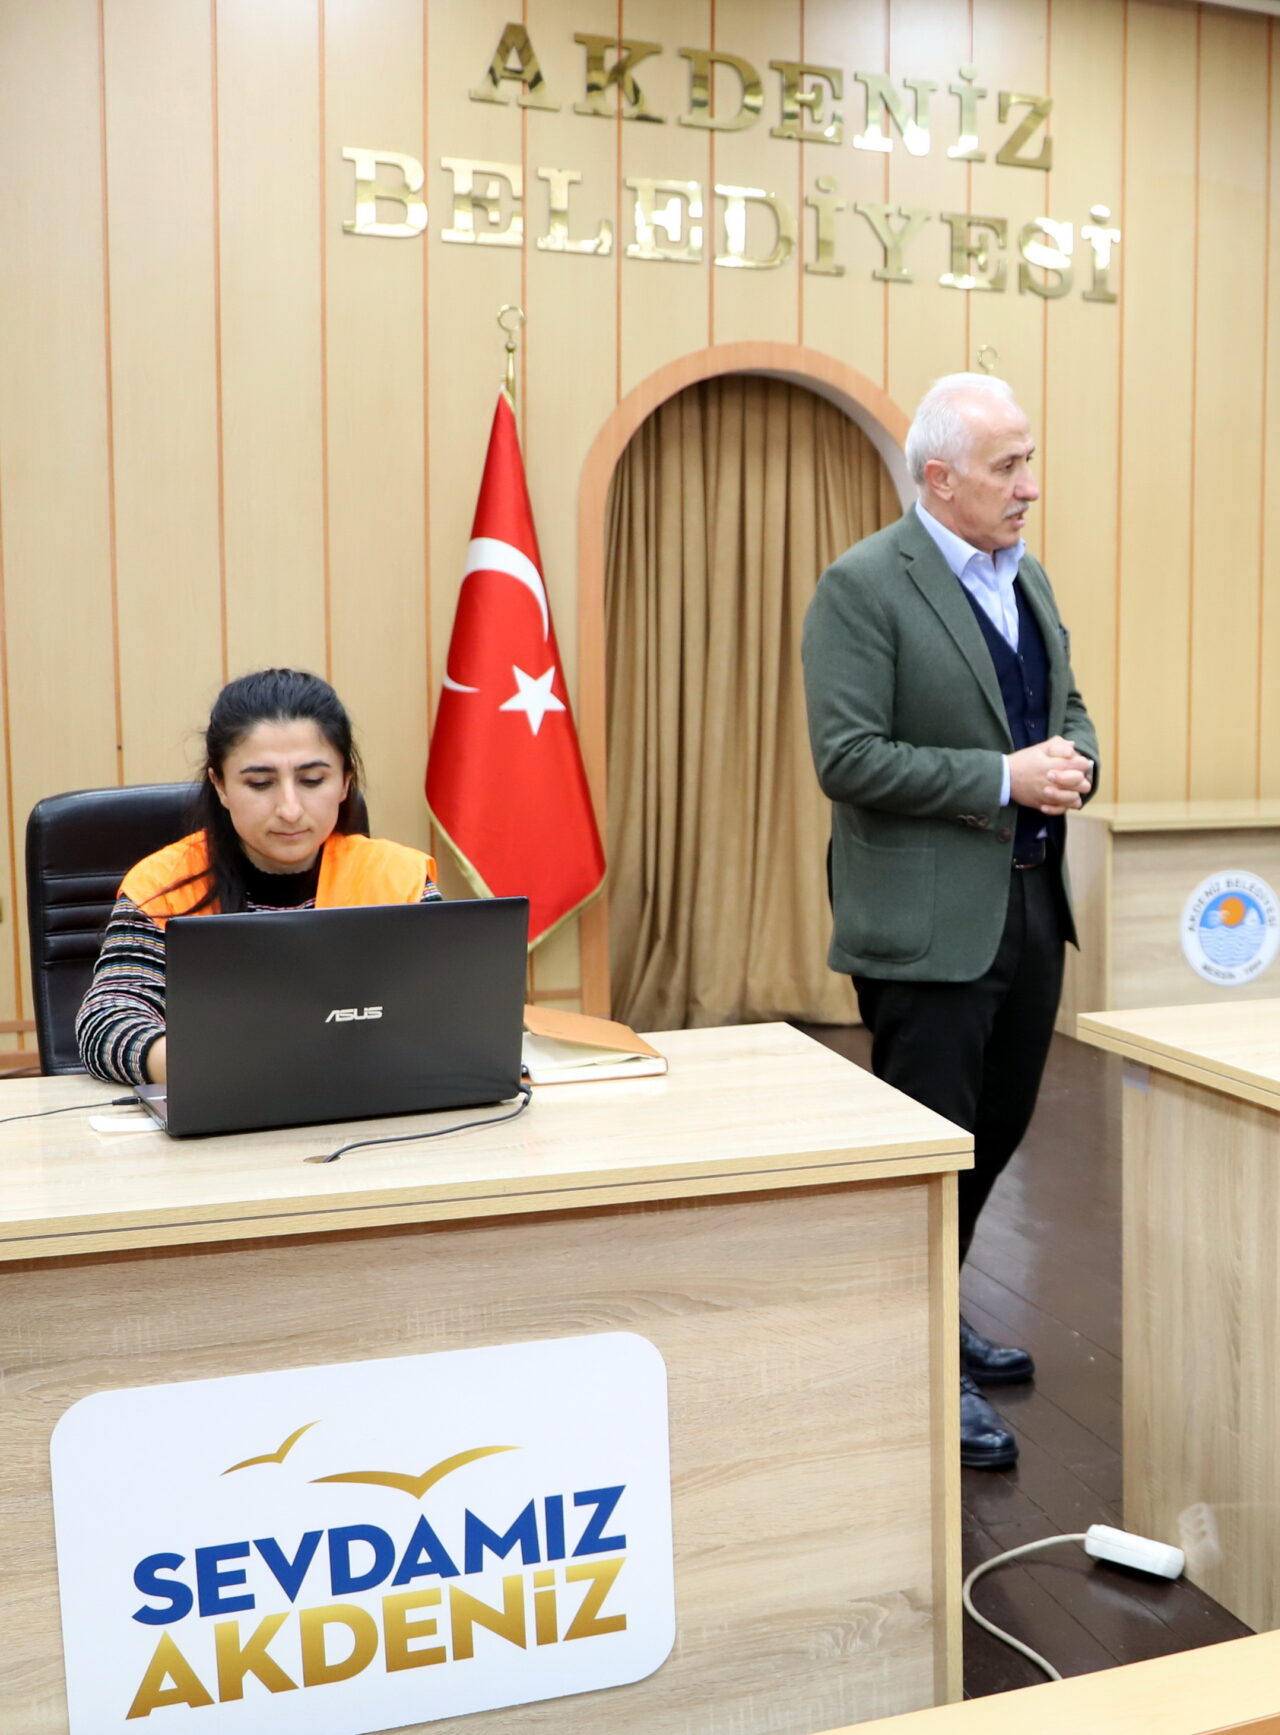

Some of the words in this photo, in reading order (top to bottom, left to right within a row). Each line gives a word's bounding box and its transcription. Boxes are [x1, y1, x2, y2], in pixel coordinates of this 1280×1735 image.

[469, 23, 1053, 171] AKDENİZ
[342, 147, 1121, 304] BELEDİYESİ
[325, 1006, 383, 1023] ASUS
[132, 1484, 626, 1625] SEVDAMIZ
